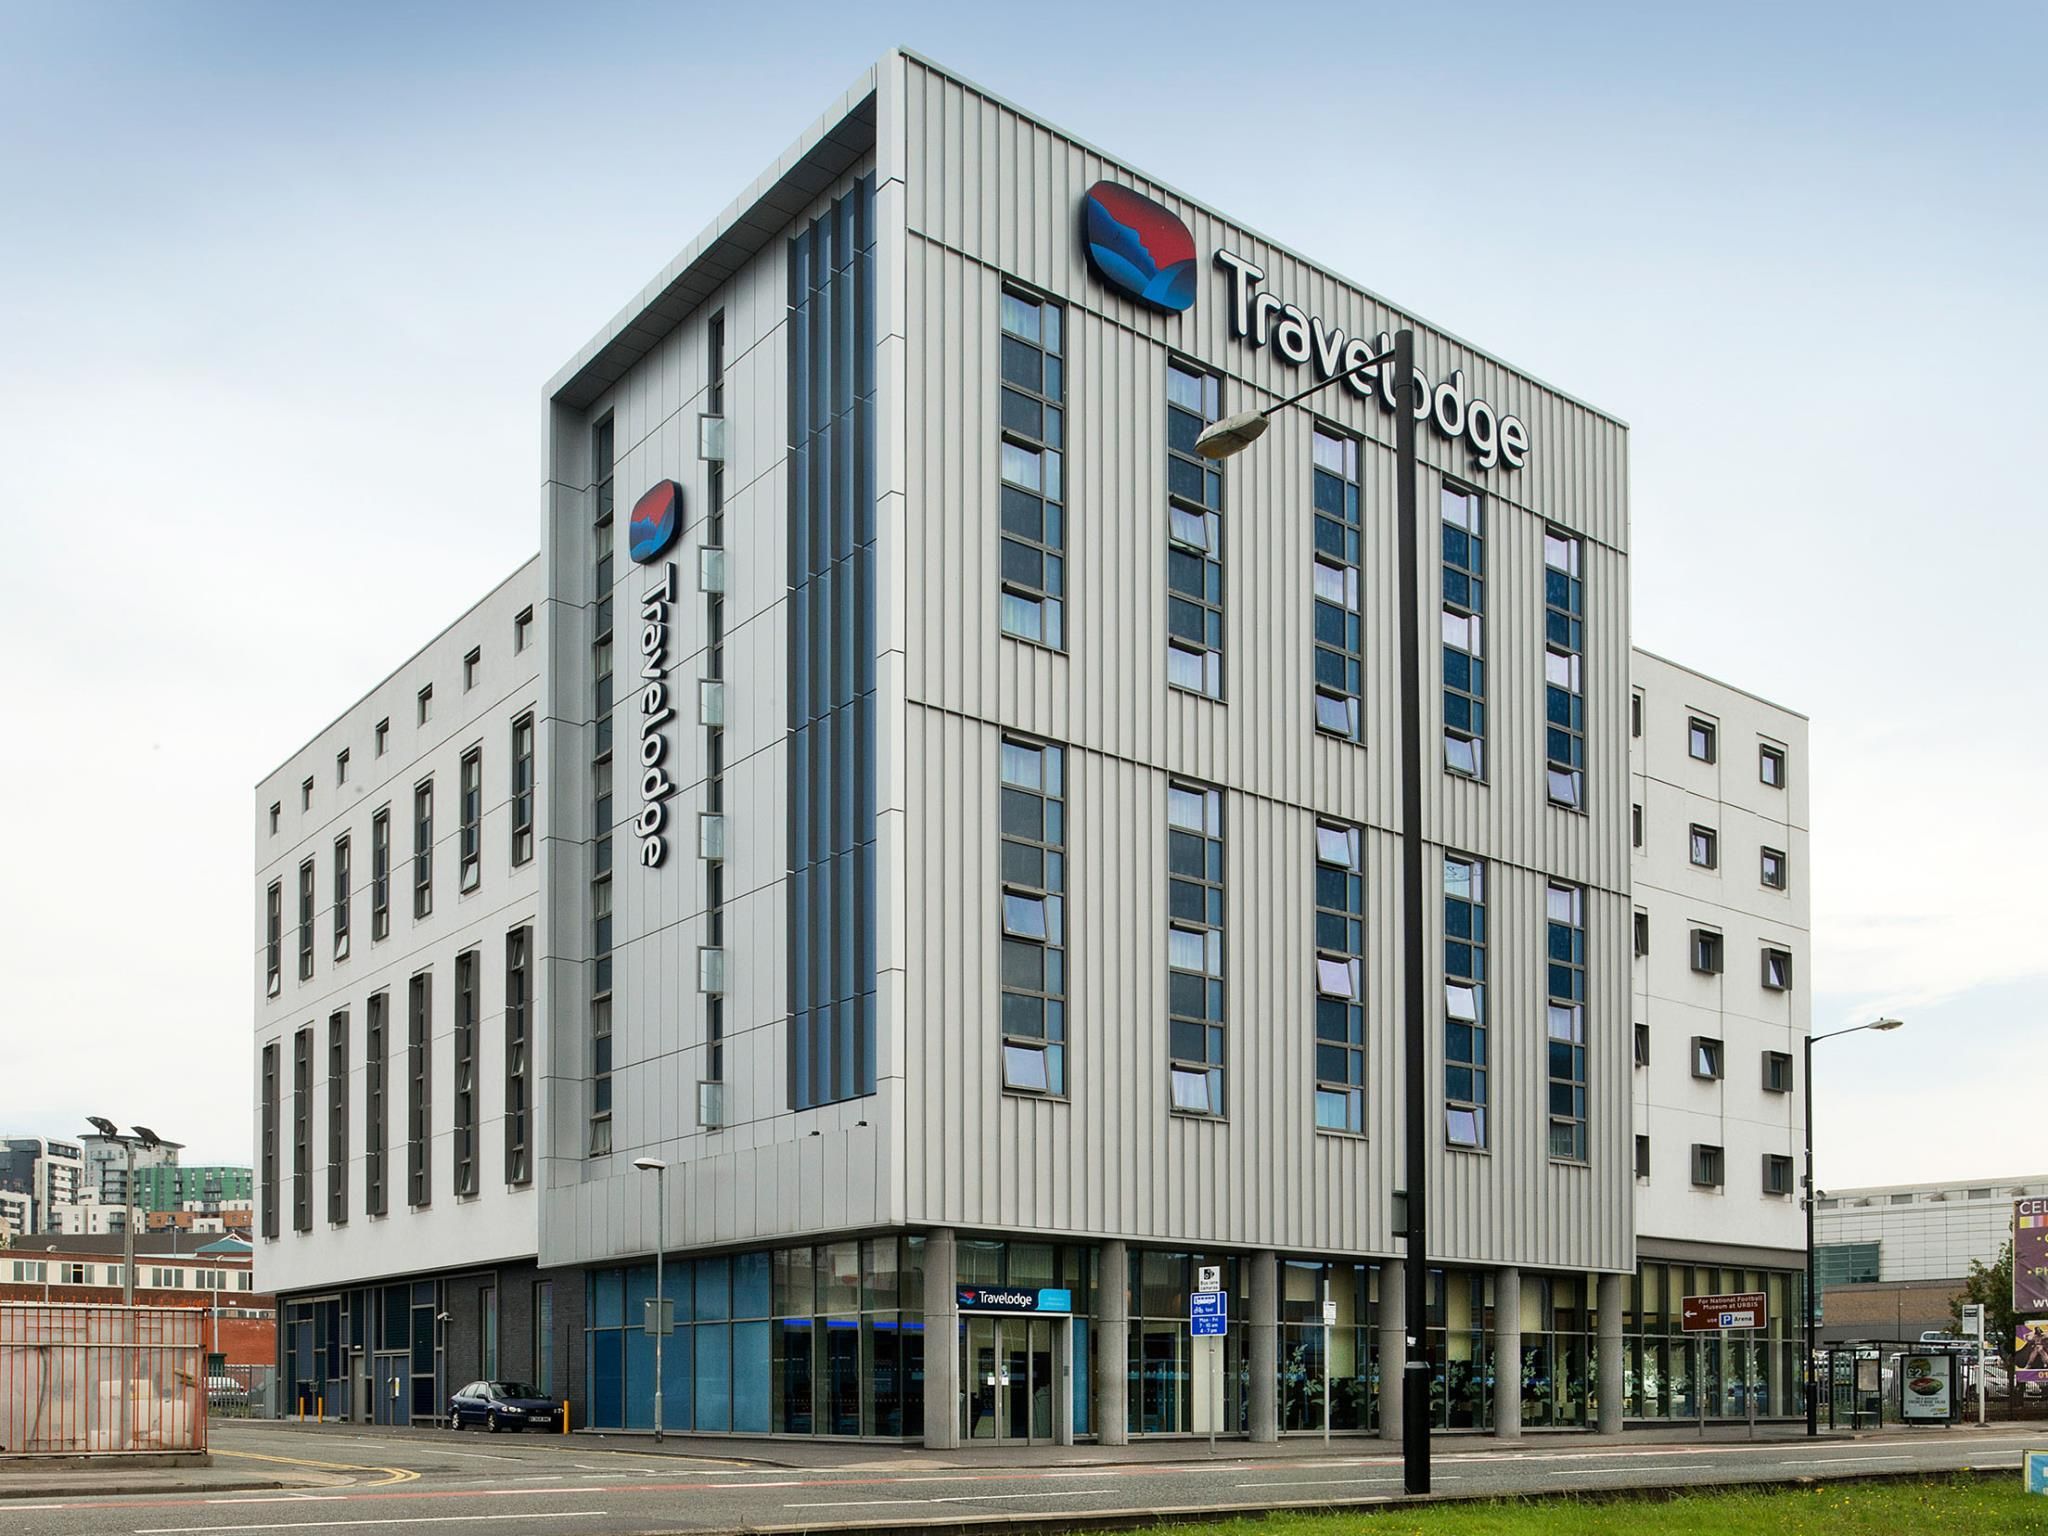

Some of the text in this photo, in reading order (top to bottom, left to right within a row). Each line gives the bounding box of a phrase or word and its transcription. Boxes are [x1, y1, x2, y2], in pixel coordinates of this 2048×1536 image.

[1213, 248, 1529, 470] Travelodge
[634, 561, 677, 868] Travelodge
[978, 1291, 1032, 1307] Travelodge
